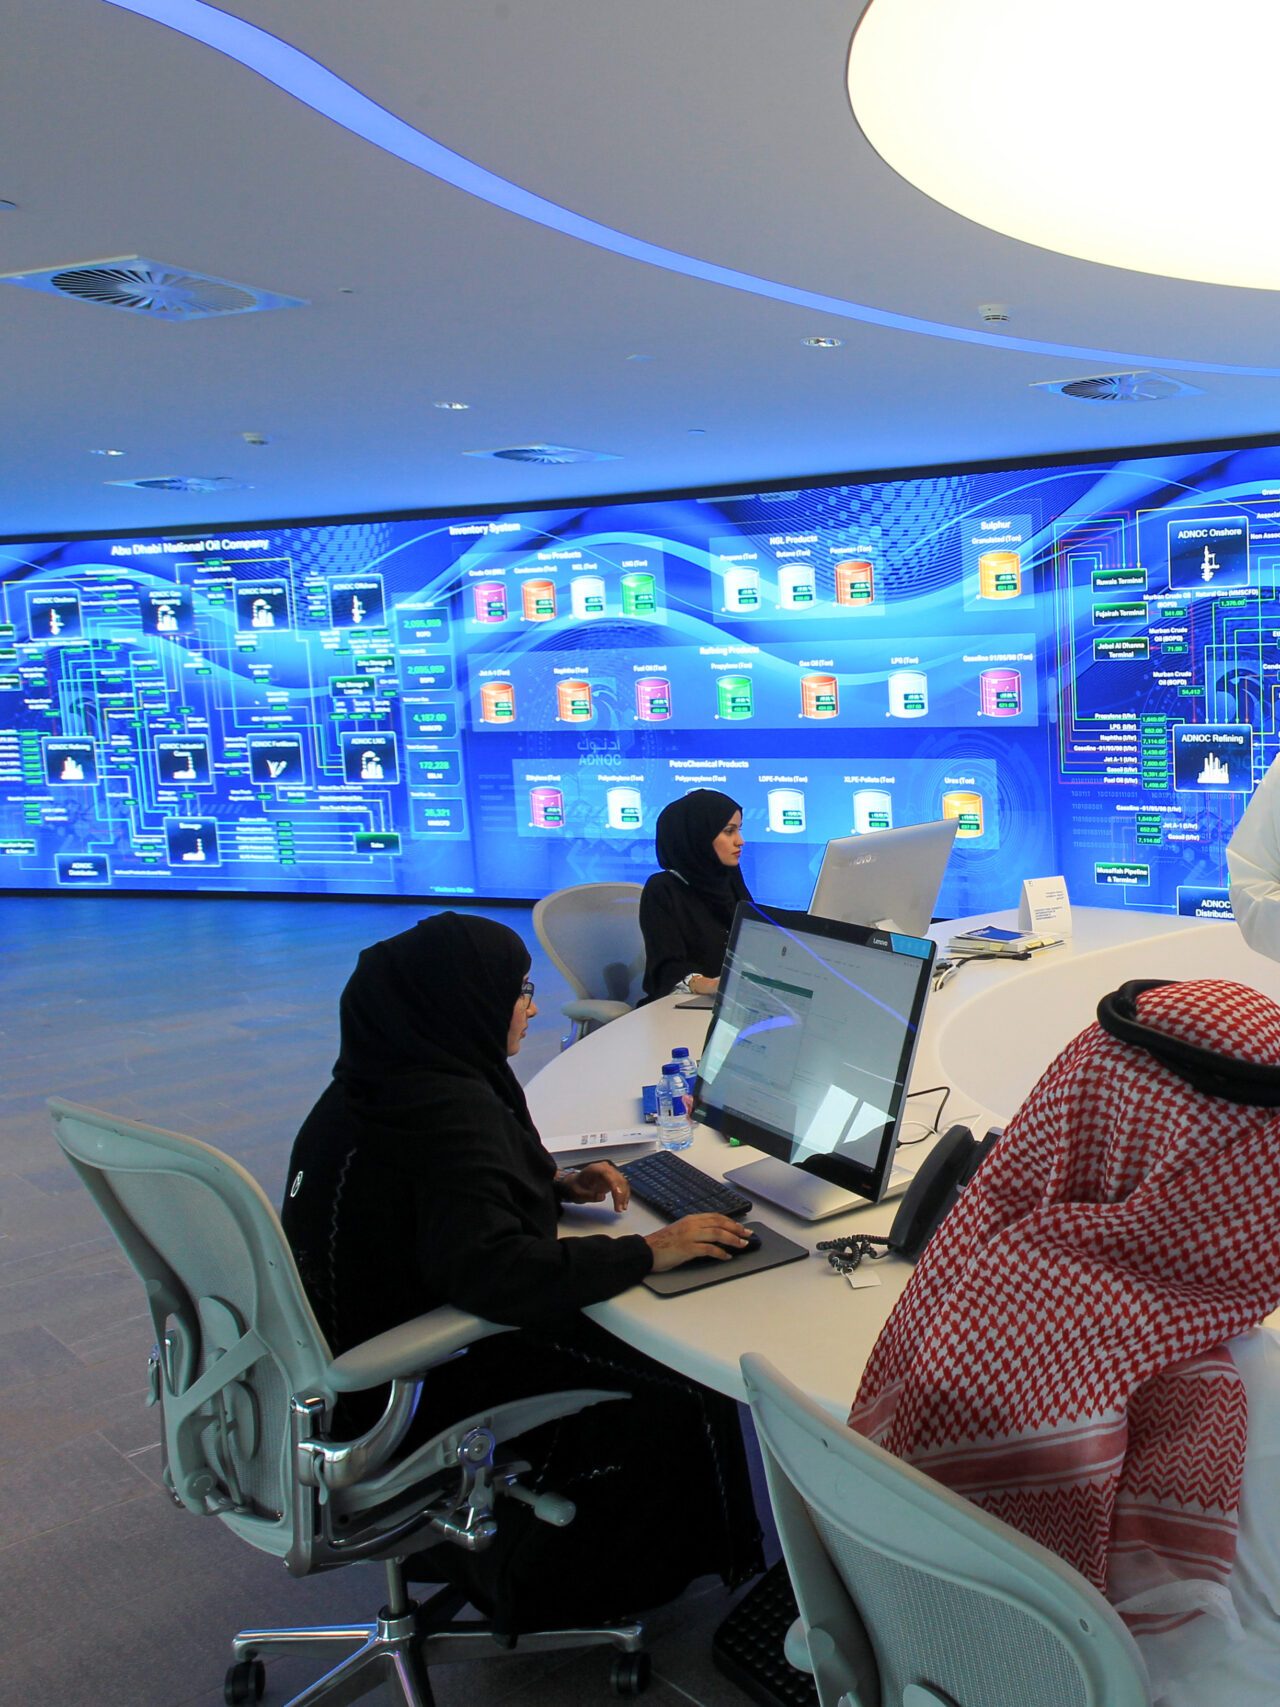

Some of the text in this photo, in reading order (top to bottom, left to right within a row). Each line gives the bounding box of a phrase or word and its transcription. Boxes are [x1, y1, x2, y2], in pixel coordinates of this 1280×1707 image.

[450, 522, 521, 536] Inventory System
[981, 520, 1010, 531] Sulphur
[1178, 527, 1242, 539] ADNOC Onshore
[770, 534, 818, 545] NGL Products
[972, 534, 1022, 544] Granulated (Ton)
[112, 538, 270, 556] Abu Dhabi National Oil Company
[552, 550, 582, 560] Products
[1181, 734, 1244, 744] ADNOC Refining
[578, 754, 622, 766] ADNOC
[669, 760, 749, 768] PetroChemical Products
[1201, 900, 1231, 908] ADNOC
[1196, 909, 1235, 920] Distributio
[872, 937, 889, 947] Lenovo
